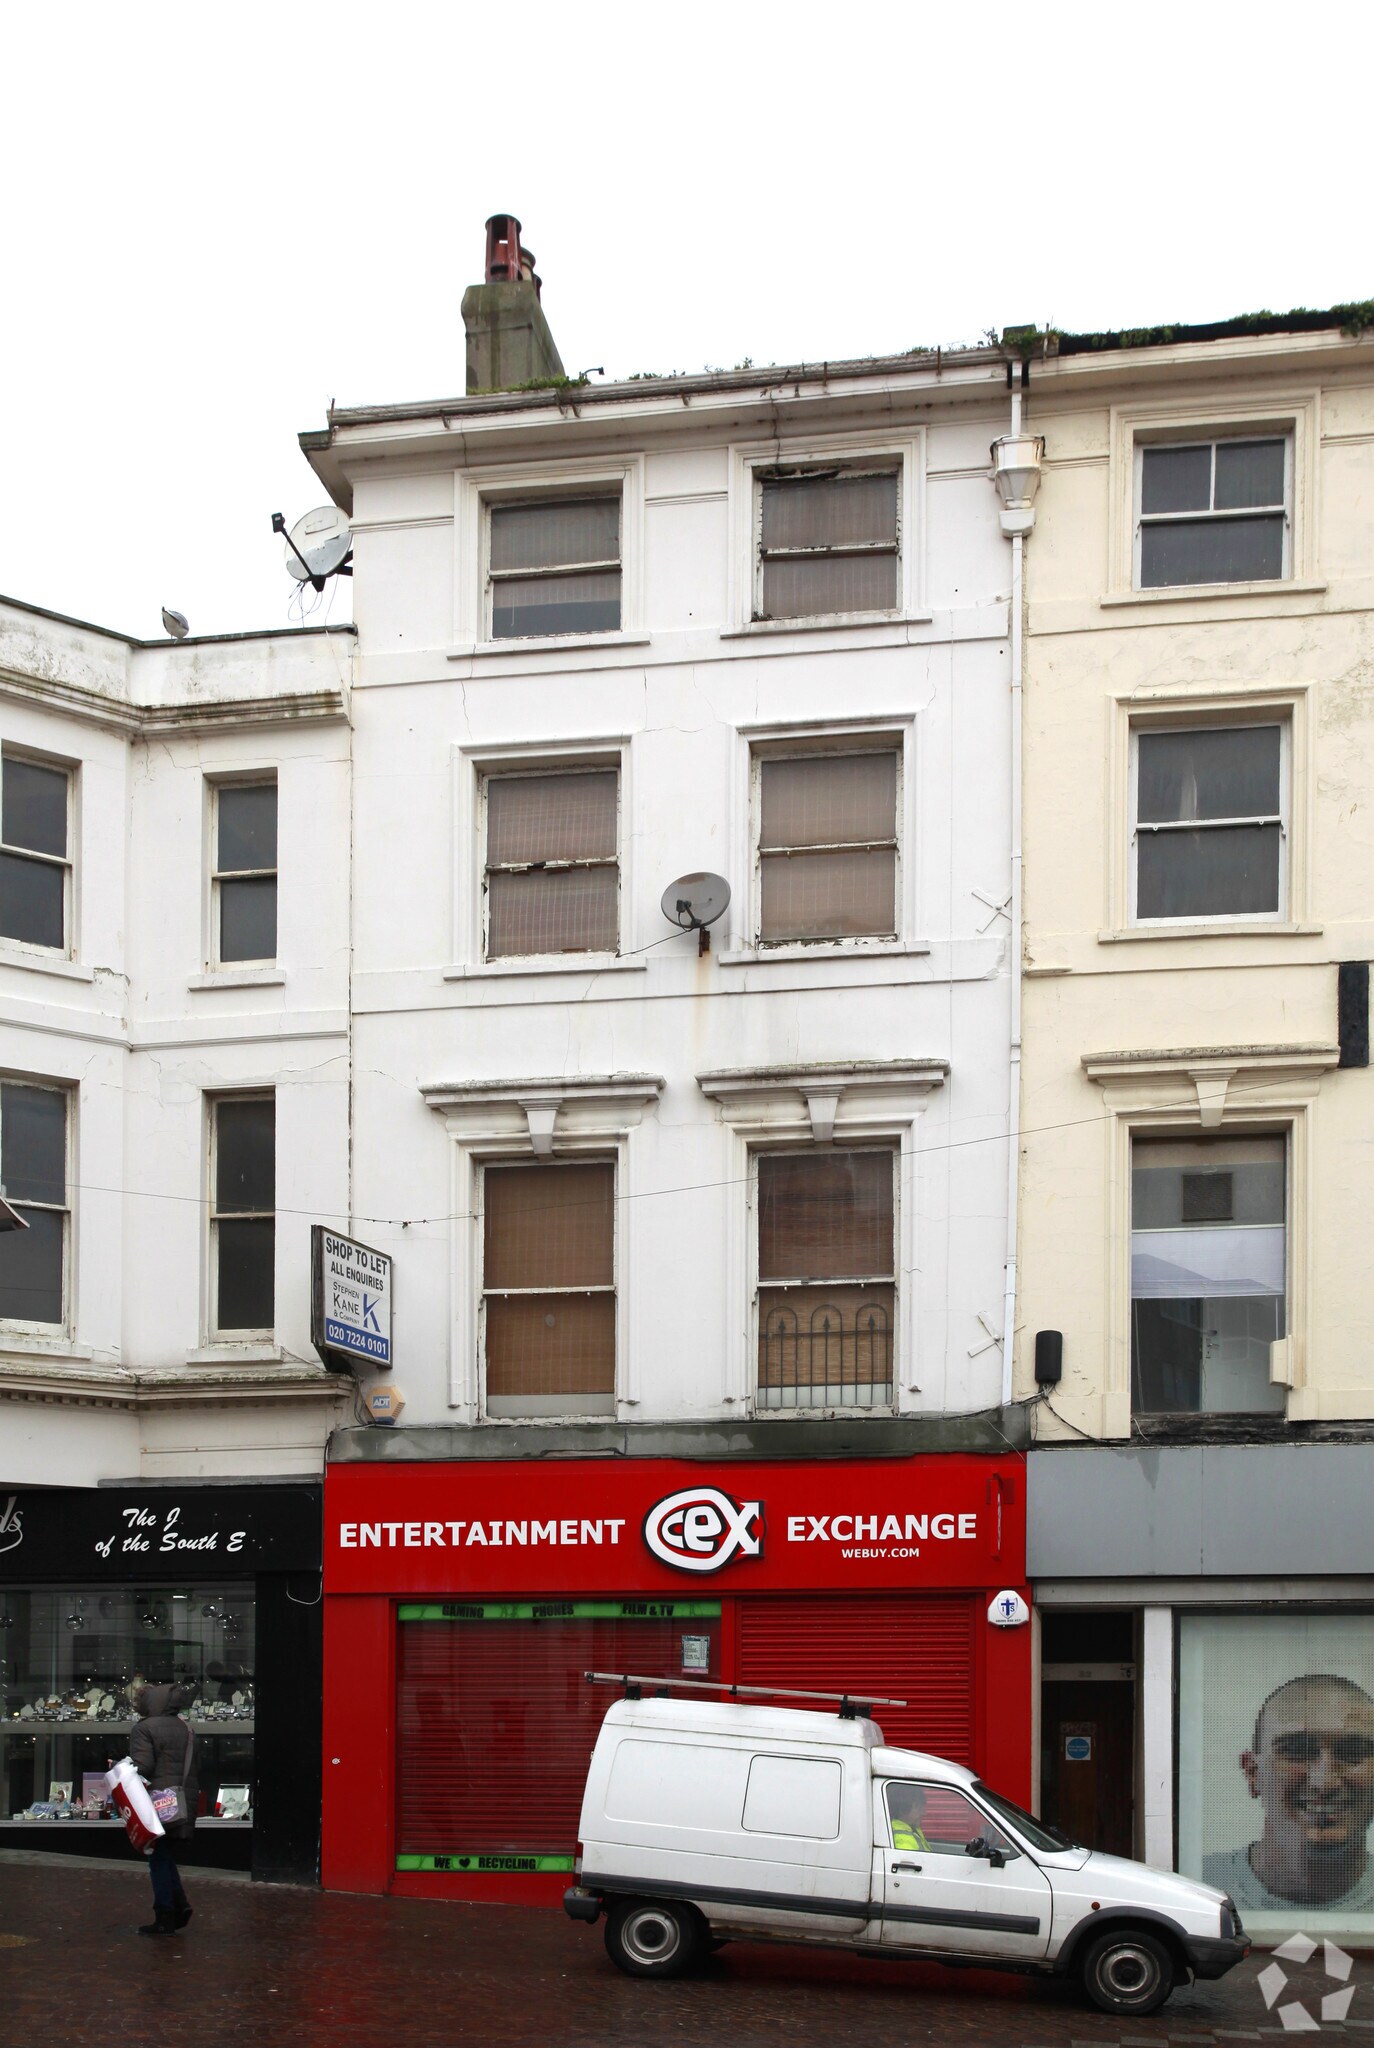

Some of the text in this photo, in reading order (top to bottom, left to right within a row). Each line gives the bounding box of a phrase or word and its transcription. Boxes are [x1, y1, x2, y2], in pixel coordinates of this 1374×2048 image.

[326, 1237, 387, 1275] SHOP TO LET
[331, 1261, 384, 1291] ALL ENQUIRIES
[333, 1309, 338, 1318] &
[328, 1324, 386, 1355] 020 7224 0101
[373, 1398, 390, 1409] ADT
[122, 1507, 181, 1531] The J
[787, 1513, 977, 1542] EXCHANGE
[340, 1519, 626, 1548] ENTERTAINMENT
[95, 1531, 246, 1558] of the South E
[841, 1548, 920, 1559] WEBUY.COM
[442, 1604, 484, 1619] GAMING
[532, 1603, 574, 1617] PHONES
[622, 1604, 674, 1617] FILM & TV
[434, 1857, 536, 1870] WE RECYCLING
